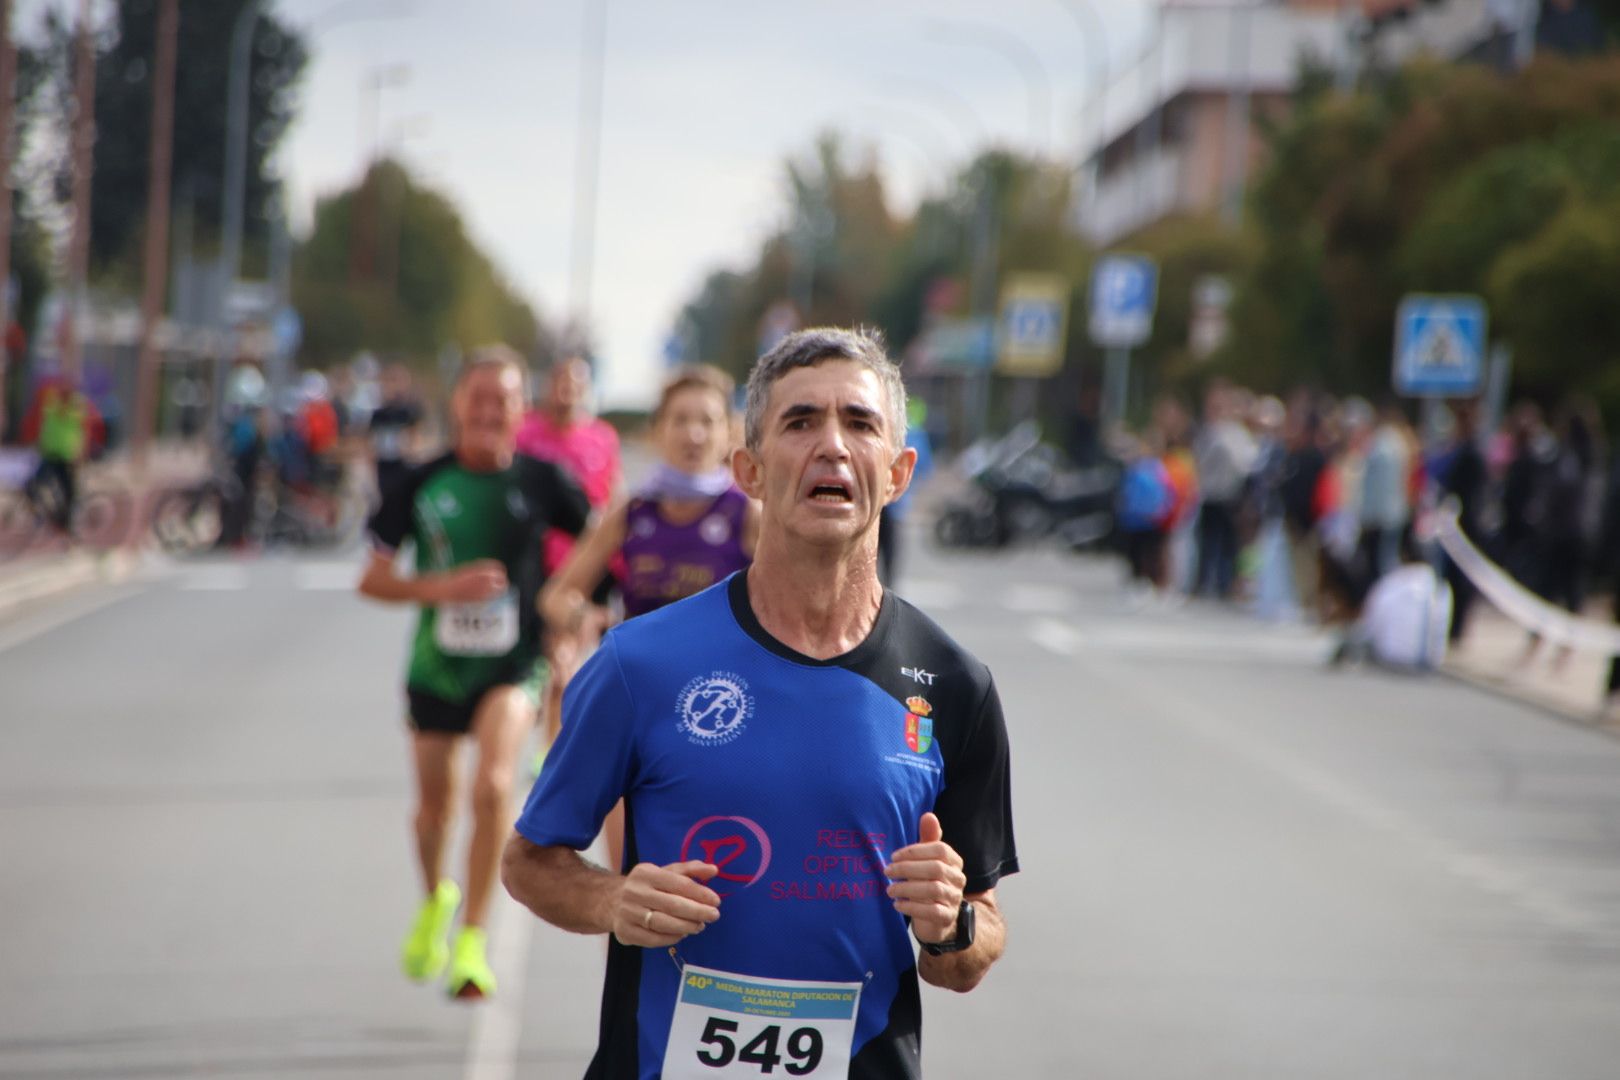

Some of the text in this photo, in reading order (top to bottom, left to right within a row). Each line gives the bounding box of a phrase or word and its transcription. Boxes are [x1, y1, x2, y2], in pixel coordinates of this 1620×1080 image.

[716, 981, 743, 994] MEDIA
[745, 988, 790, 999] MARATON
[792, 991, 841, 1001] DIPUTACION
[742, 996, 796, 1008] SALAMANCA
[696, 1016, 824, 1076] 549
